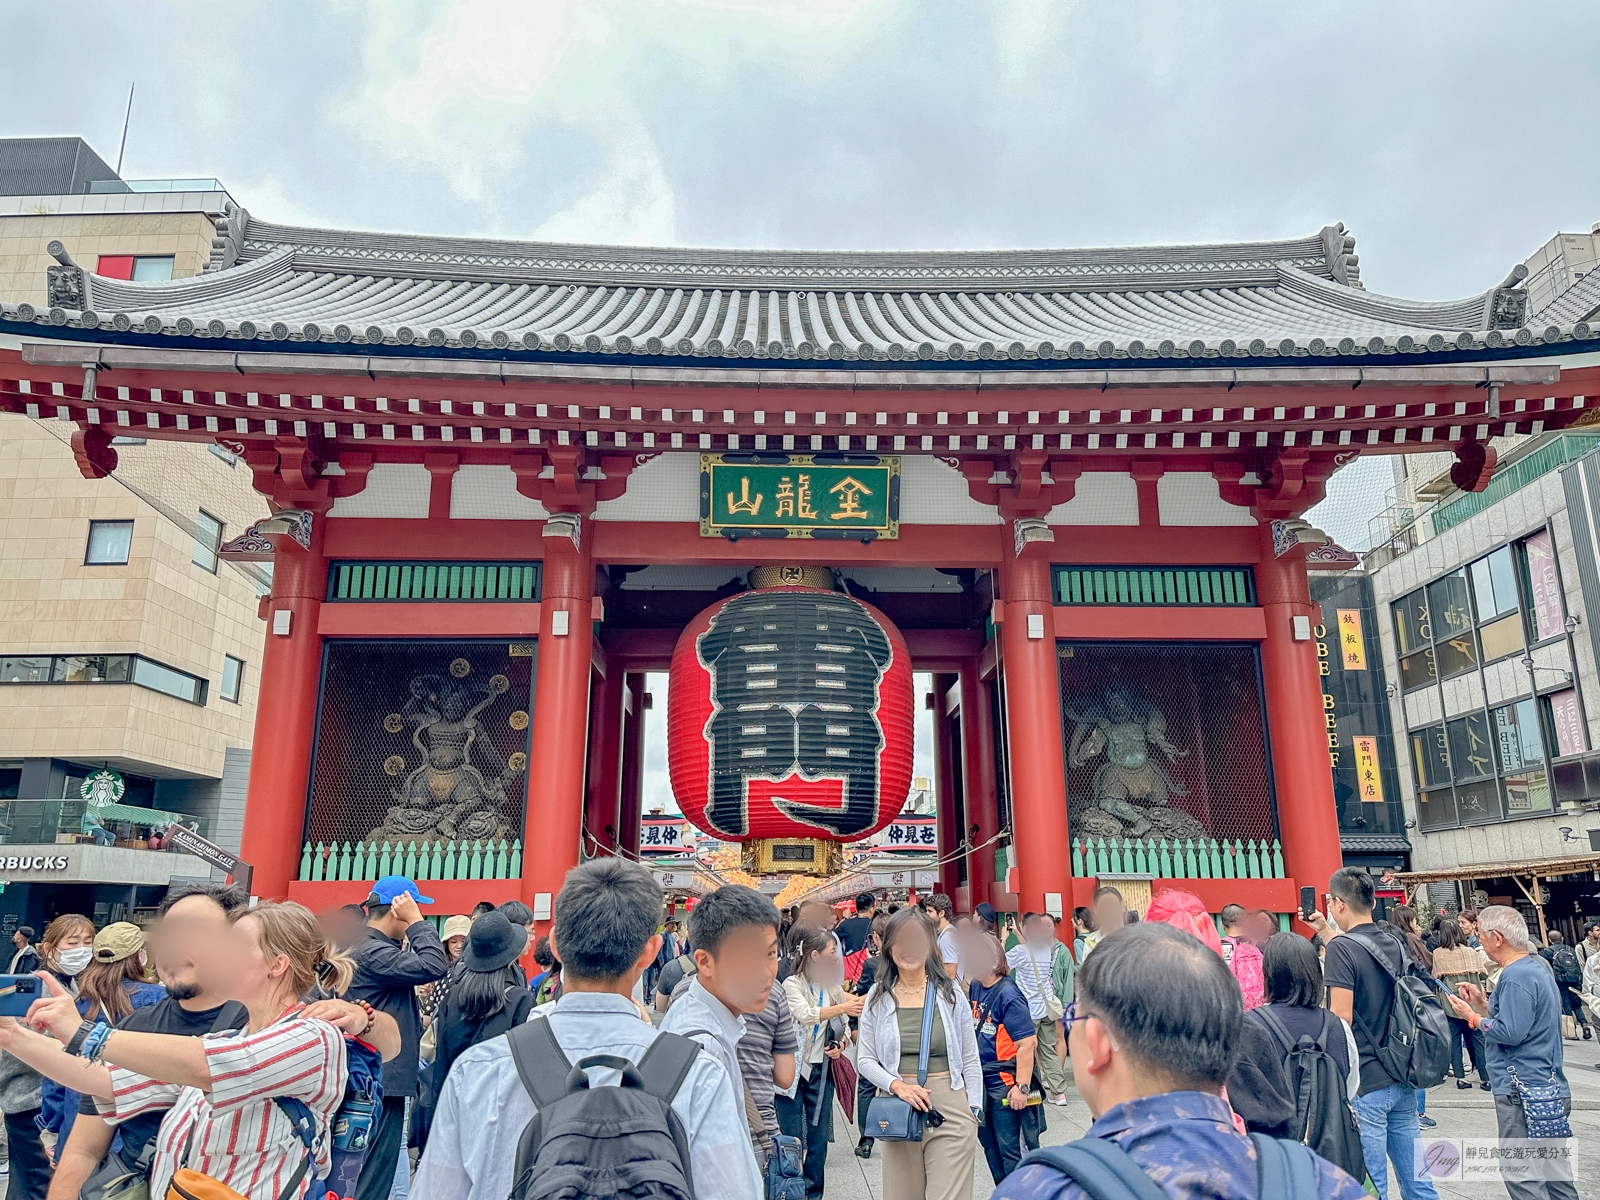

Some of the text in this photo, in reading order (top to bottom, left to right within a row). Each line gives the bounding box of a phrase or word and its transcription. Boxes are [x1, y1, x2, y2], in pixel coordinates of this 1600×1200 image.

[1343, 613, 1360, 664] 鉄板焼
[1314, 617, 1340, 768] OBE BEEF
[1359, 740, 1376, 796] 雷門東店
[177, 831, 219, 858] KAMINARIMON
[218, 854, 236, 867] GATE
